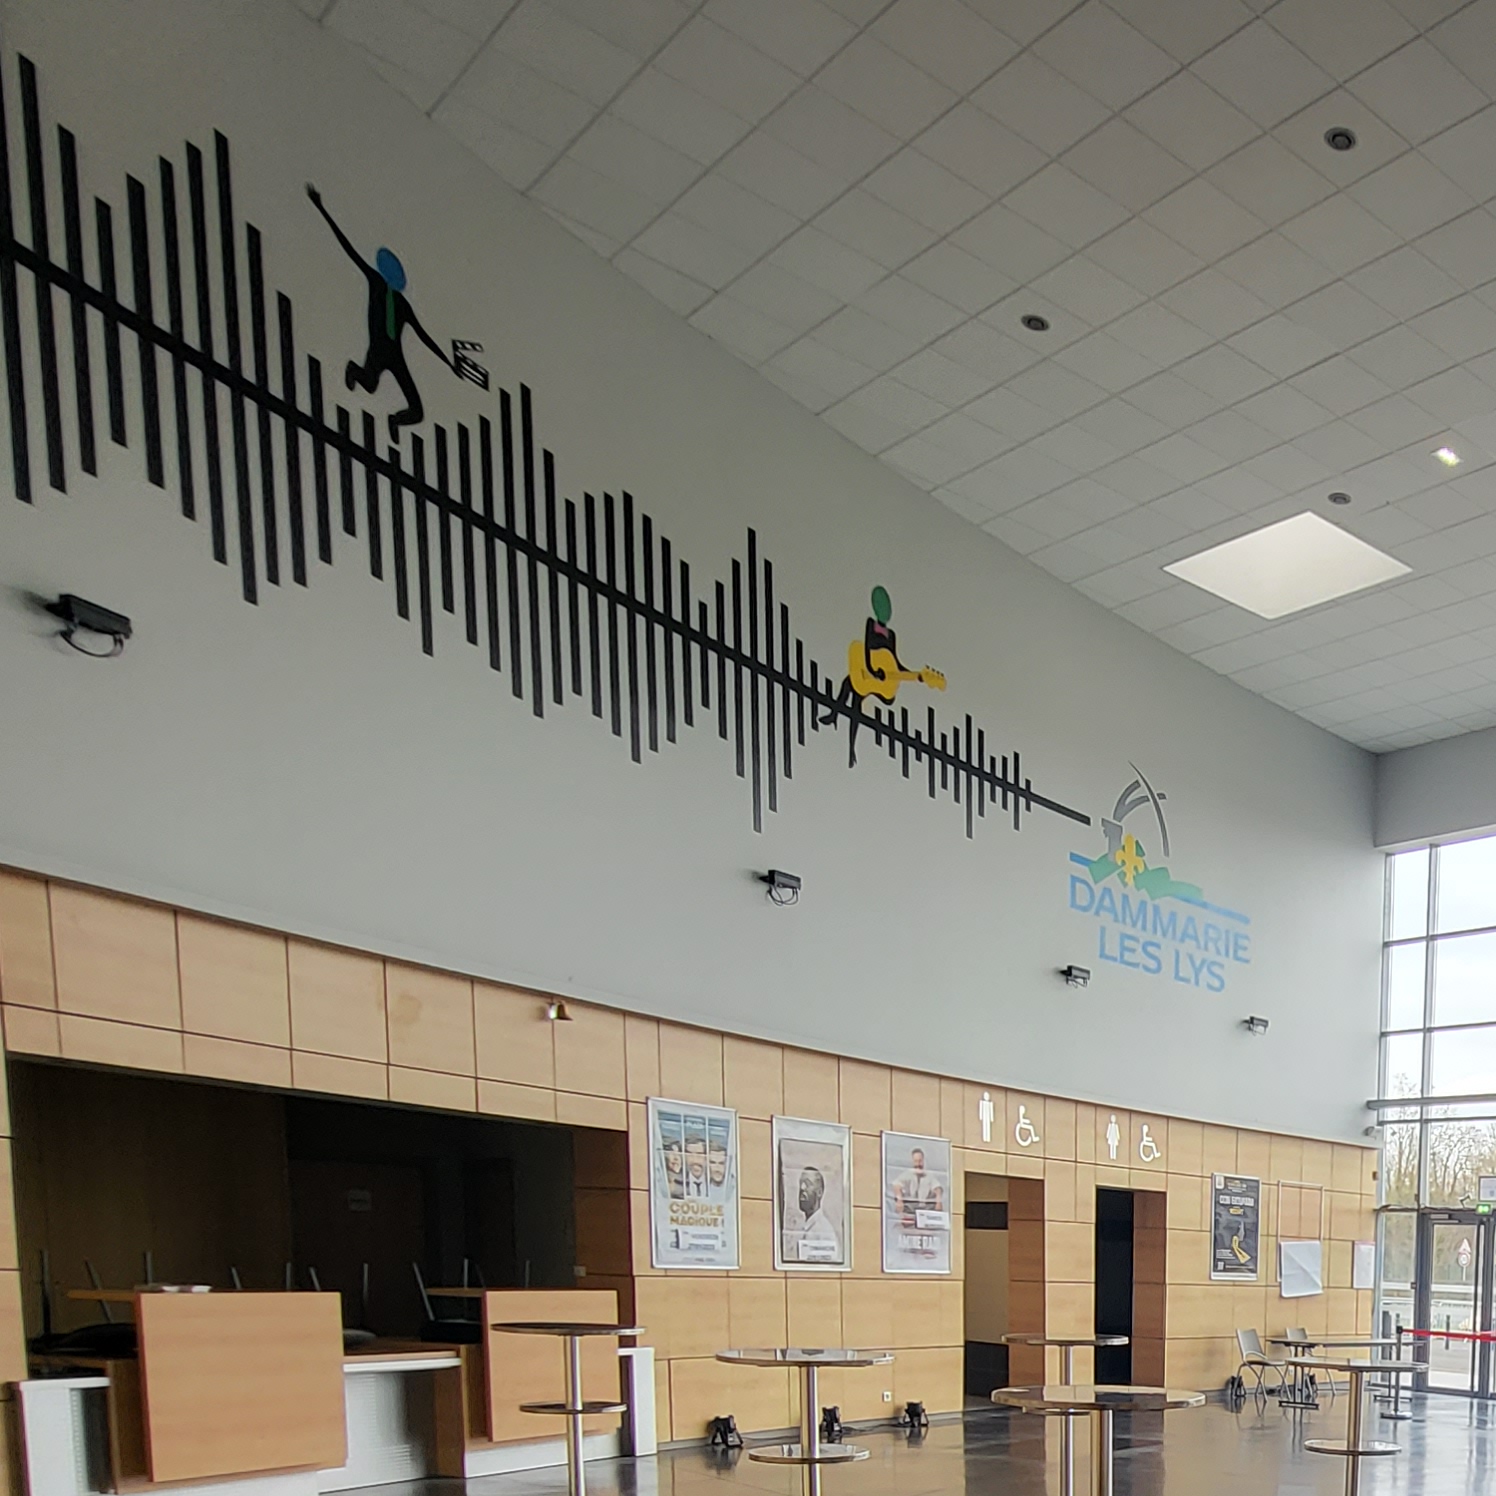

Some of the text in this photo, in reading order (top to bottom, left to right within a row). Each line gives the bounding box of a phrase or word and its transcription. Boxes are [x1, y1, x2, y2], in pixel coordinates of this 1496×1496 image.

[1069, 874, 1250, 964] DAMMARIE
[1099, 926, 1226, 993] LES LYS
[669, 1201, 724, 1217] COUPLE
